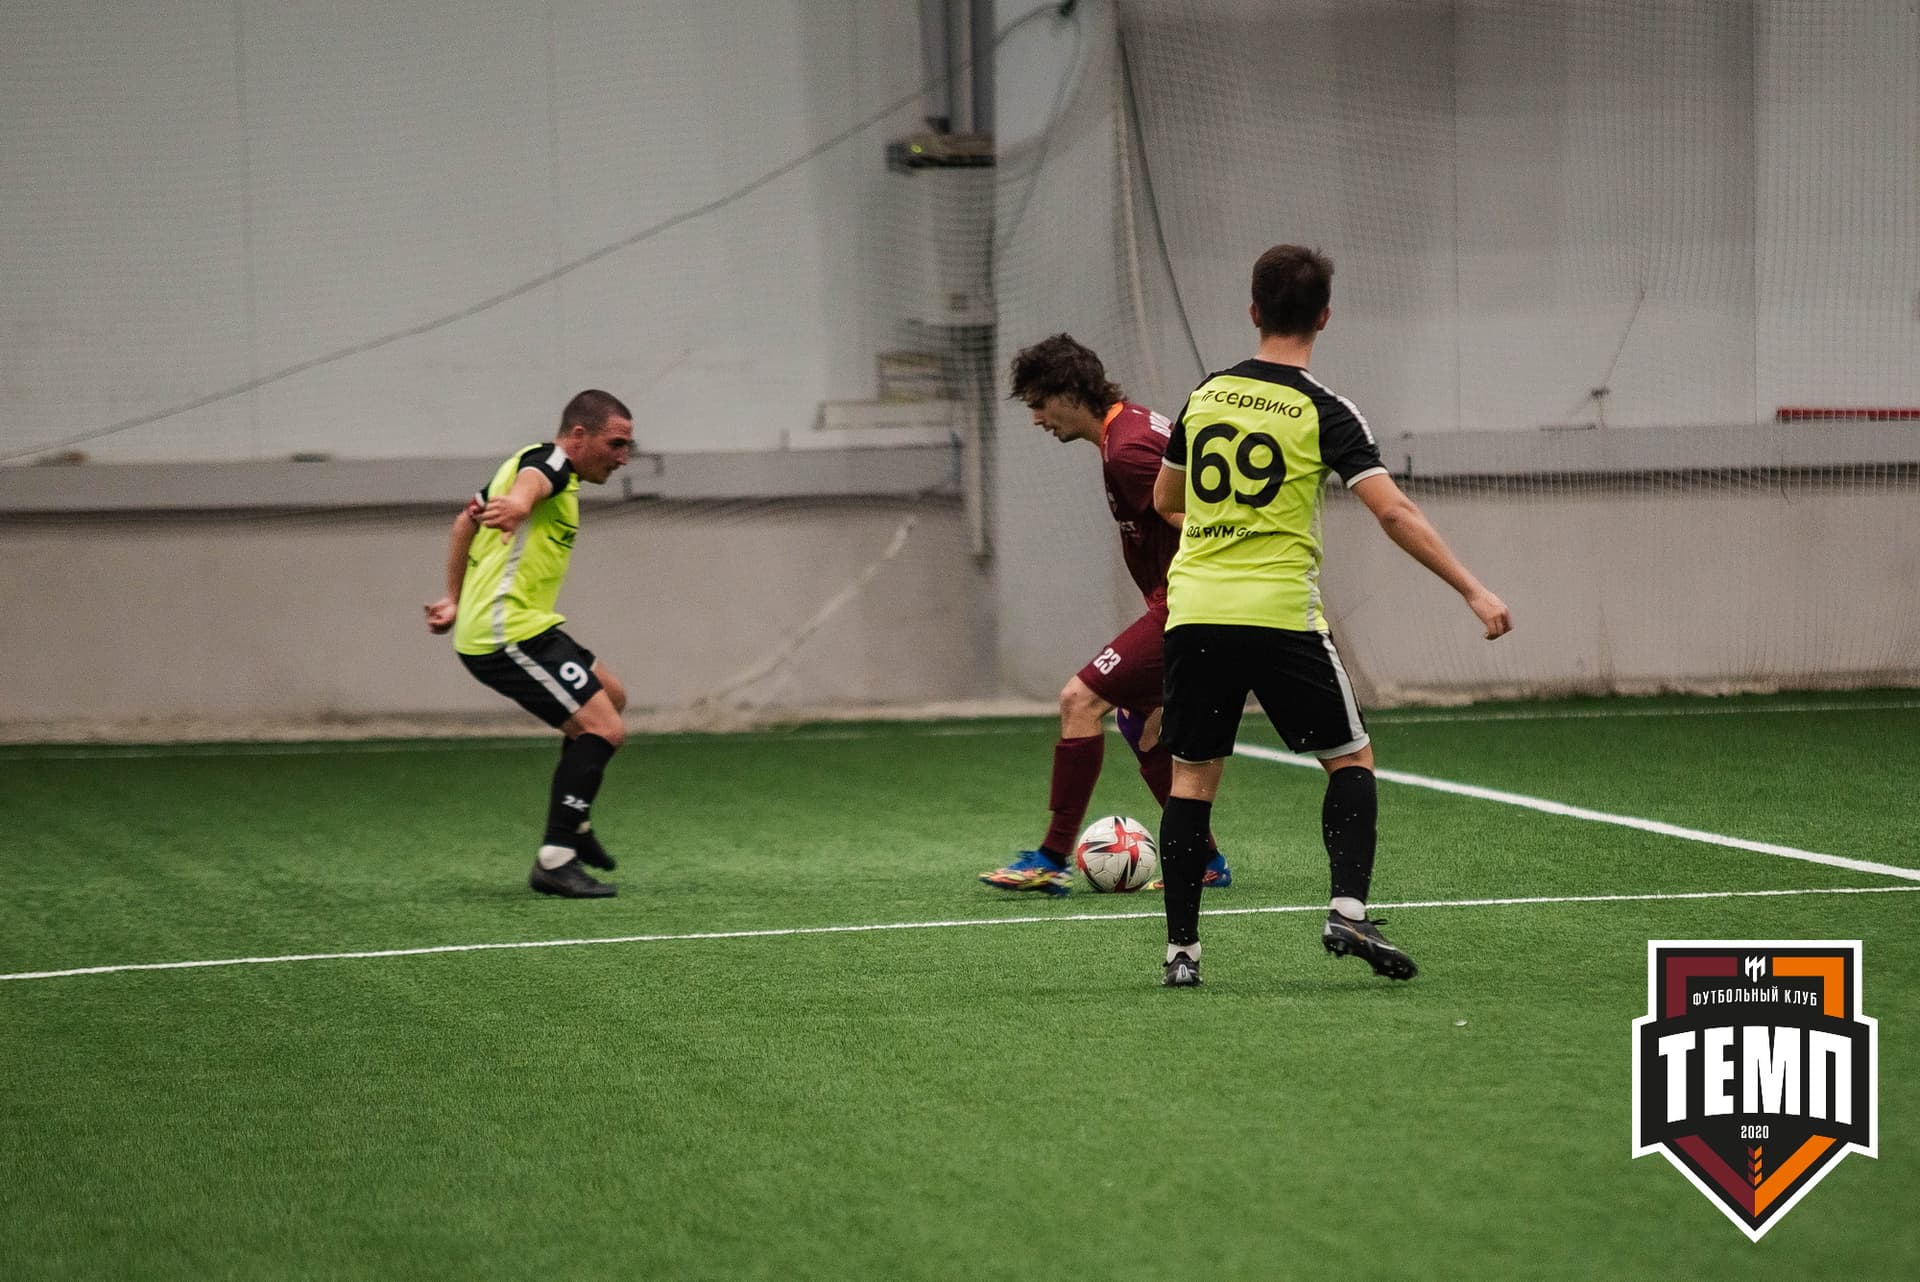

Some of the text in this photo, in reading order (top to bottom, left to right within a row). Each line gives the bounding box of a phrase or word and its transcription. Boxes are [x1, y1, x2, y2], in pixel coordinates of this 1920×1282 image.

[1214, 391, 1303, 418] сервико
[1191, 423, 1287, 509] 69
[1203, 525, 1235, 538] RVM
[1093, 647, 1122, 675] 23
[559, 661, 589, 690] 9
